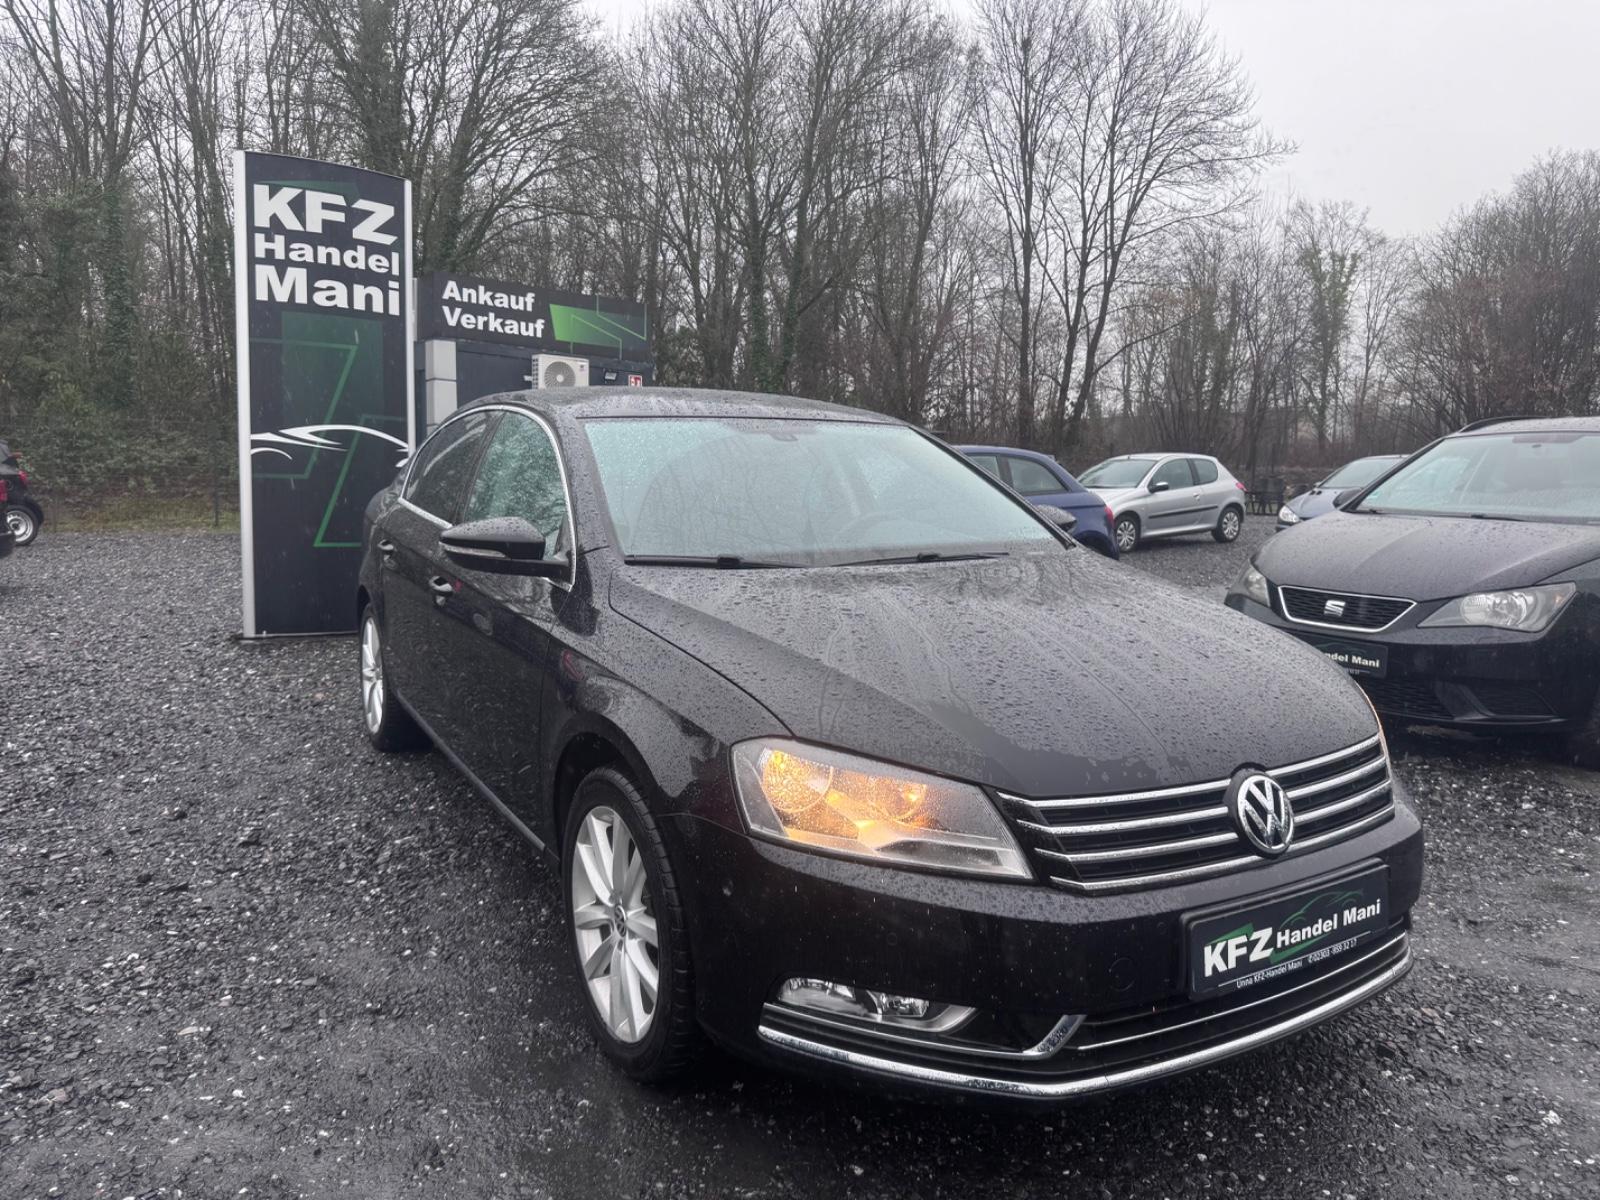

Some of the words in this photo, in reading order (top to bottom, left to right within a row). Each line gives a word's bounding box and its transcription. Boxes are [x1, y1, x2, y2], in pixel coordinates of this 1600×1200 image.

[253, 184, 398, 246] KFZ
[254, 233, 400, 276] Handel
[254, 264, 400, 316] Mani
[442, 280, 535, 312] Ankauf
[442, 306, 545, 339] Verkauf
[1351, 655, 1380, 668] Mani
[1204, 927, 1274, 977] KFZ
[1276, 913, 1337, 949] Handel
[1343, 899, 1380, 927] Mani
